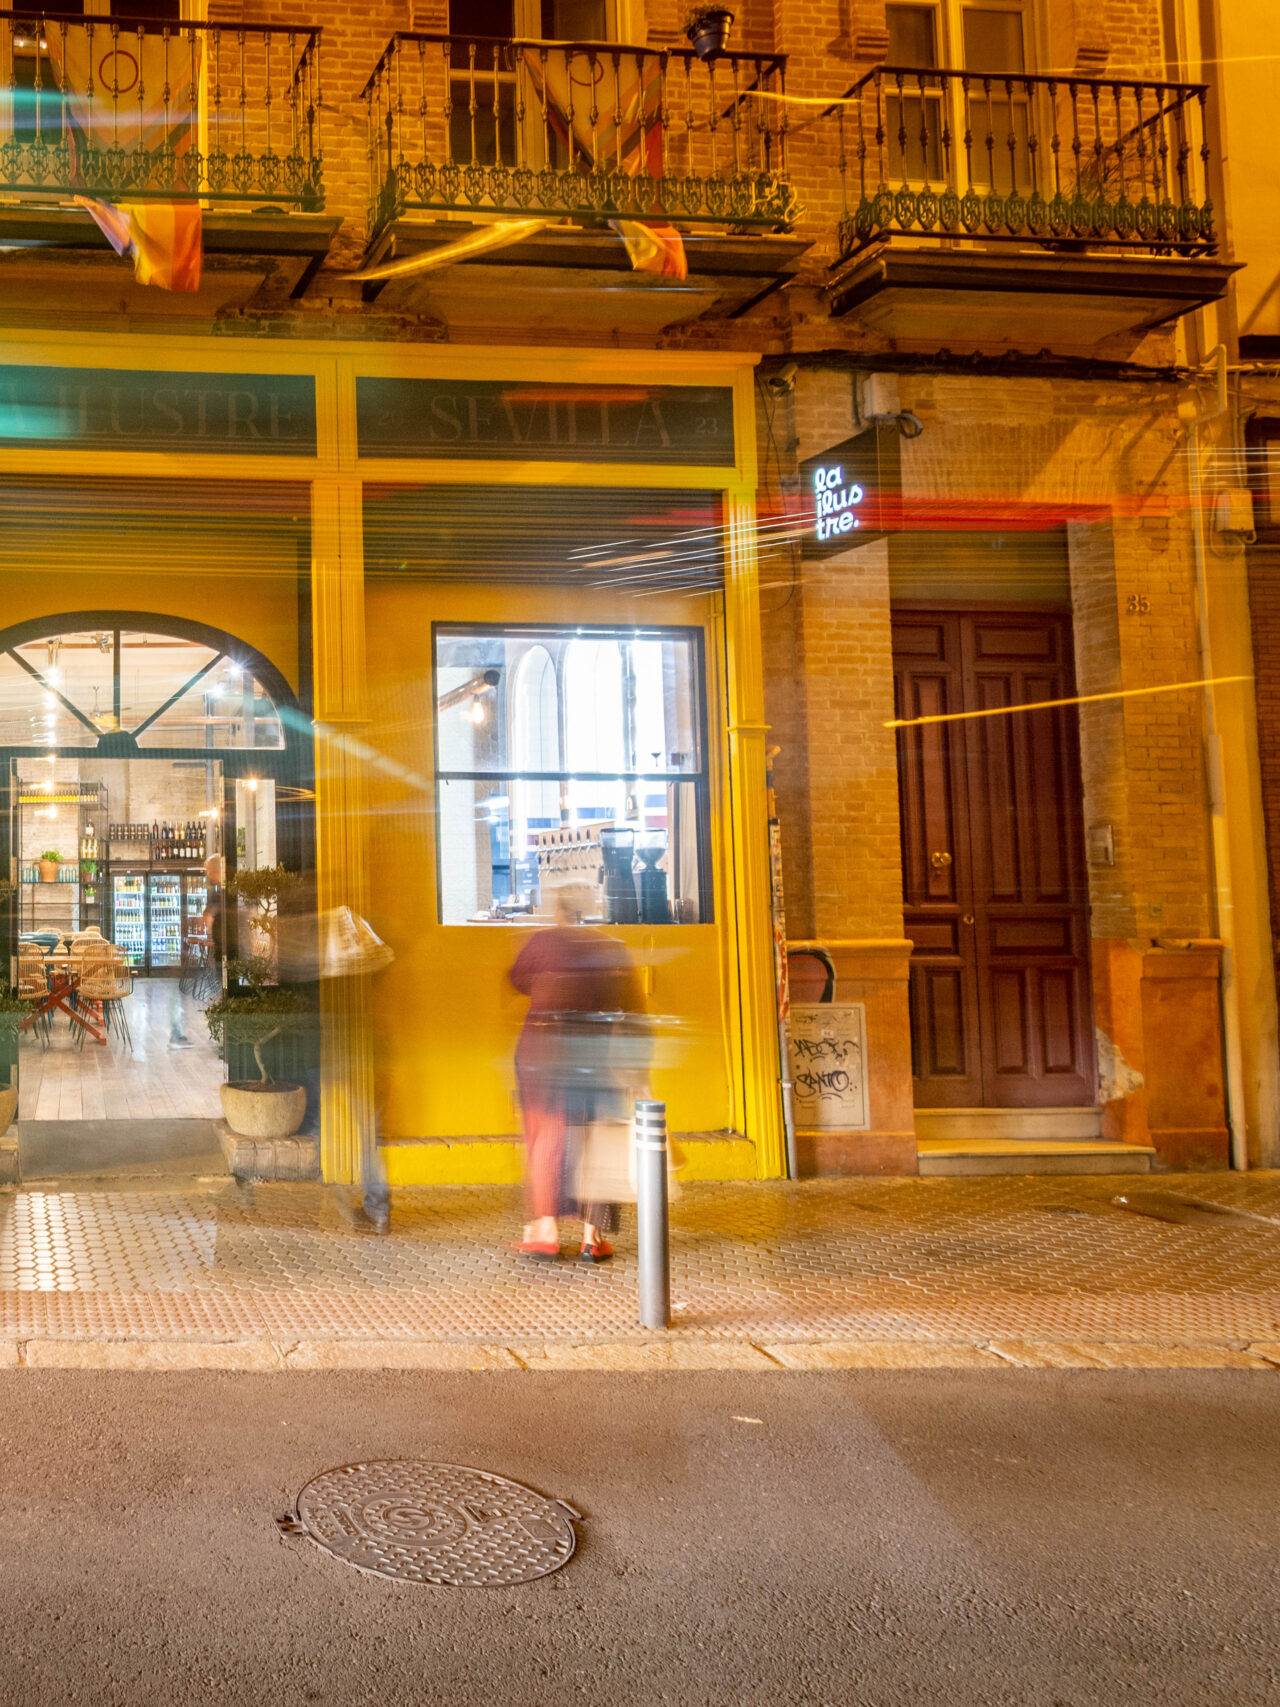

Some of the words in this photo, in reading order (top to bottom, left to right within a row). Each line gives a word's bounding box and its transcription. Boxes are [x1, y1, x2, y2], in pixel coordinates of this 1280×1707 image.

[56, 383, 300, 440] ILUSTRE
[430, 394, 675, 448] SEVILLA
[695, 417, 718, 434] 23
[814, 466, 843, 493] la
[816, 483, 864, 518] ilus
[814, 511, 860, 541] tre.
[1127, 594, 1151, 615] 35
